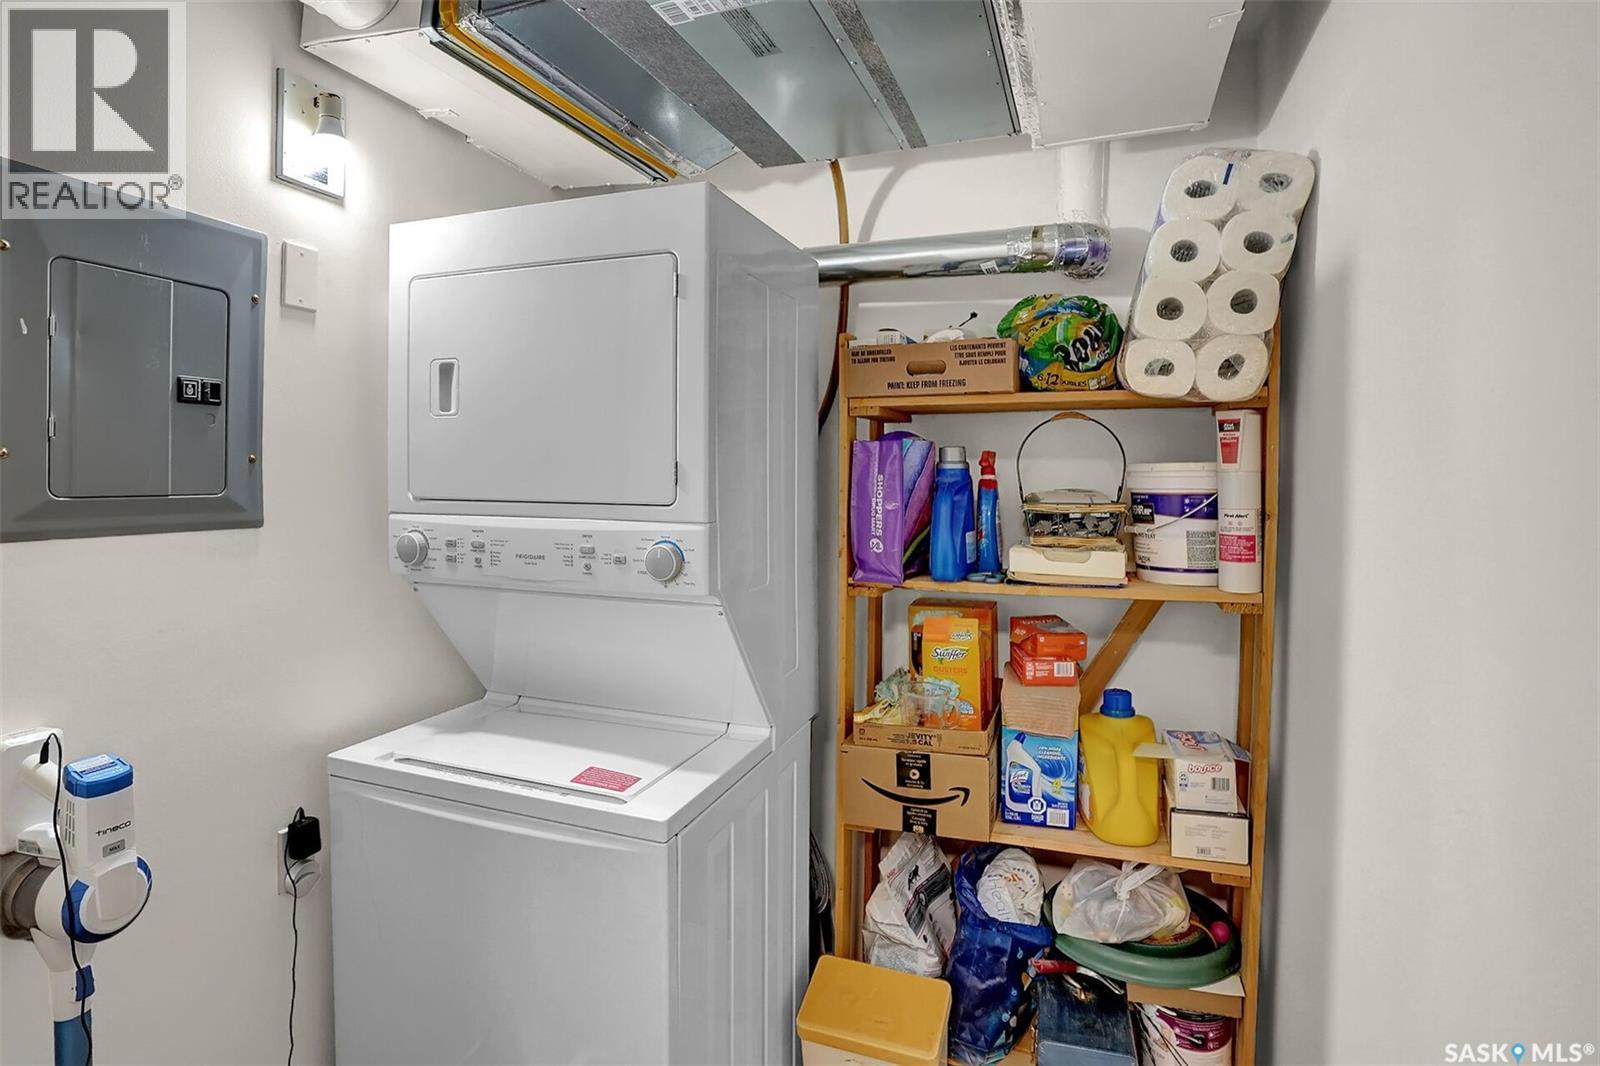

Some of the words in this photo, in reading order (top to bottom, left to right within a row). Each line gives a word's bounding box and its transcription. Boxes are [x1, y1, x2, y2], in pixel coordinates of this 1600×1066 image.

[906, 380, 920, 389] KEEP
[921, 380, 938, 389] FROM
[939, 378, 967, 388] FREEZING
[876, 474, 884, 536] SHOPPERS
[515, 552, 546, 561] FRIGIDAIRE
[930, 646, 969, 661] Swiffer
[1188, 763, 1223, 775] bounce
